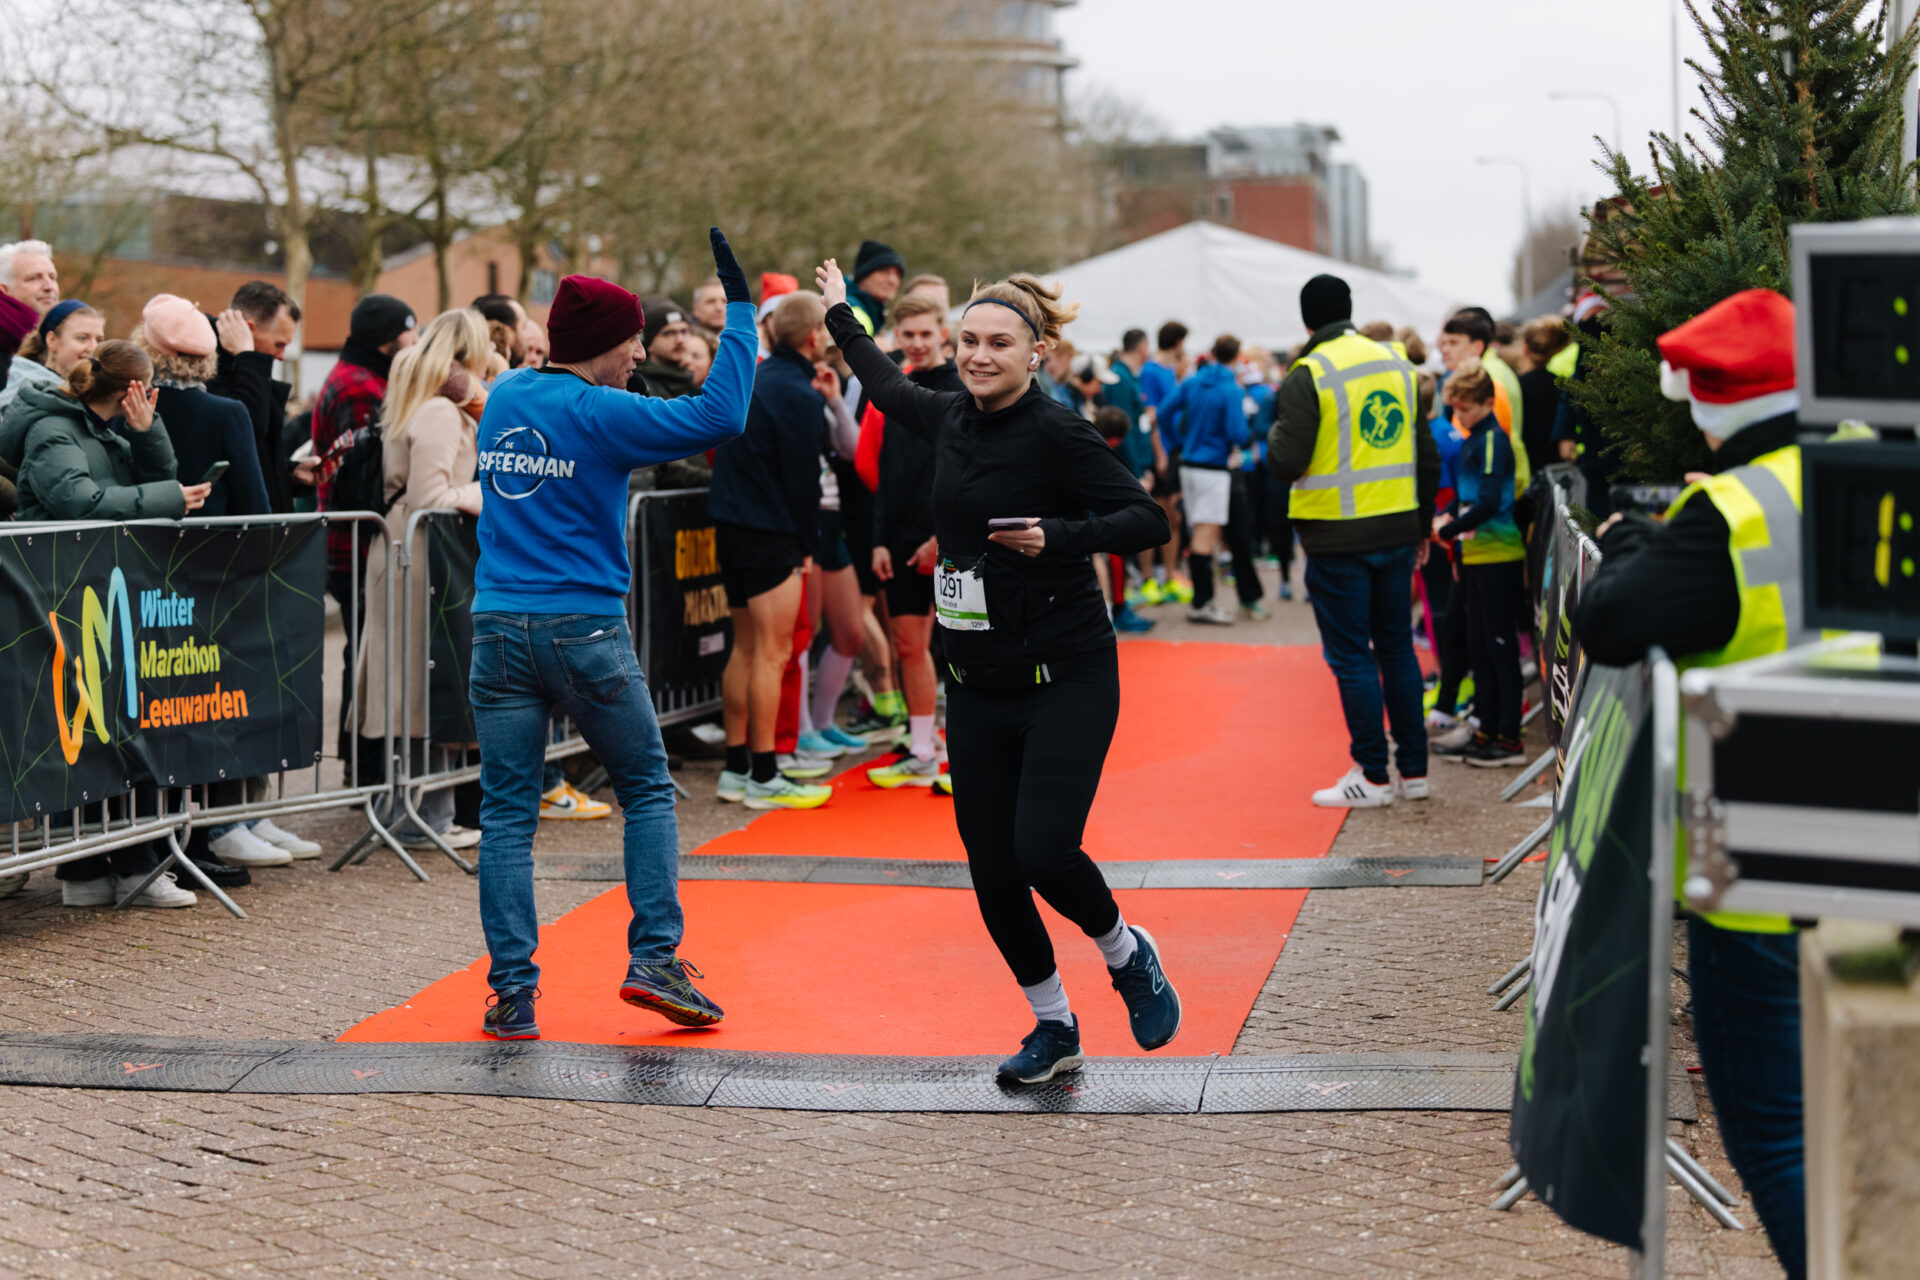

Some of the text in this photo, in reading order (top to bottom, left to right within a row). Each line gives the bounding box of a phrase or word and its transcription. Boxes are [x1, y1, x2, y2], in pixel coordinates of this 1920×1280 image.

[939, 574, 962, 599] 1291
[140, 588, 195, 628] Winter
[140, 636, 221, 679] Marathon
[139, 682, 249, 729] Leeuwarden
